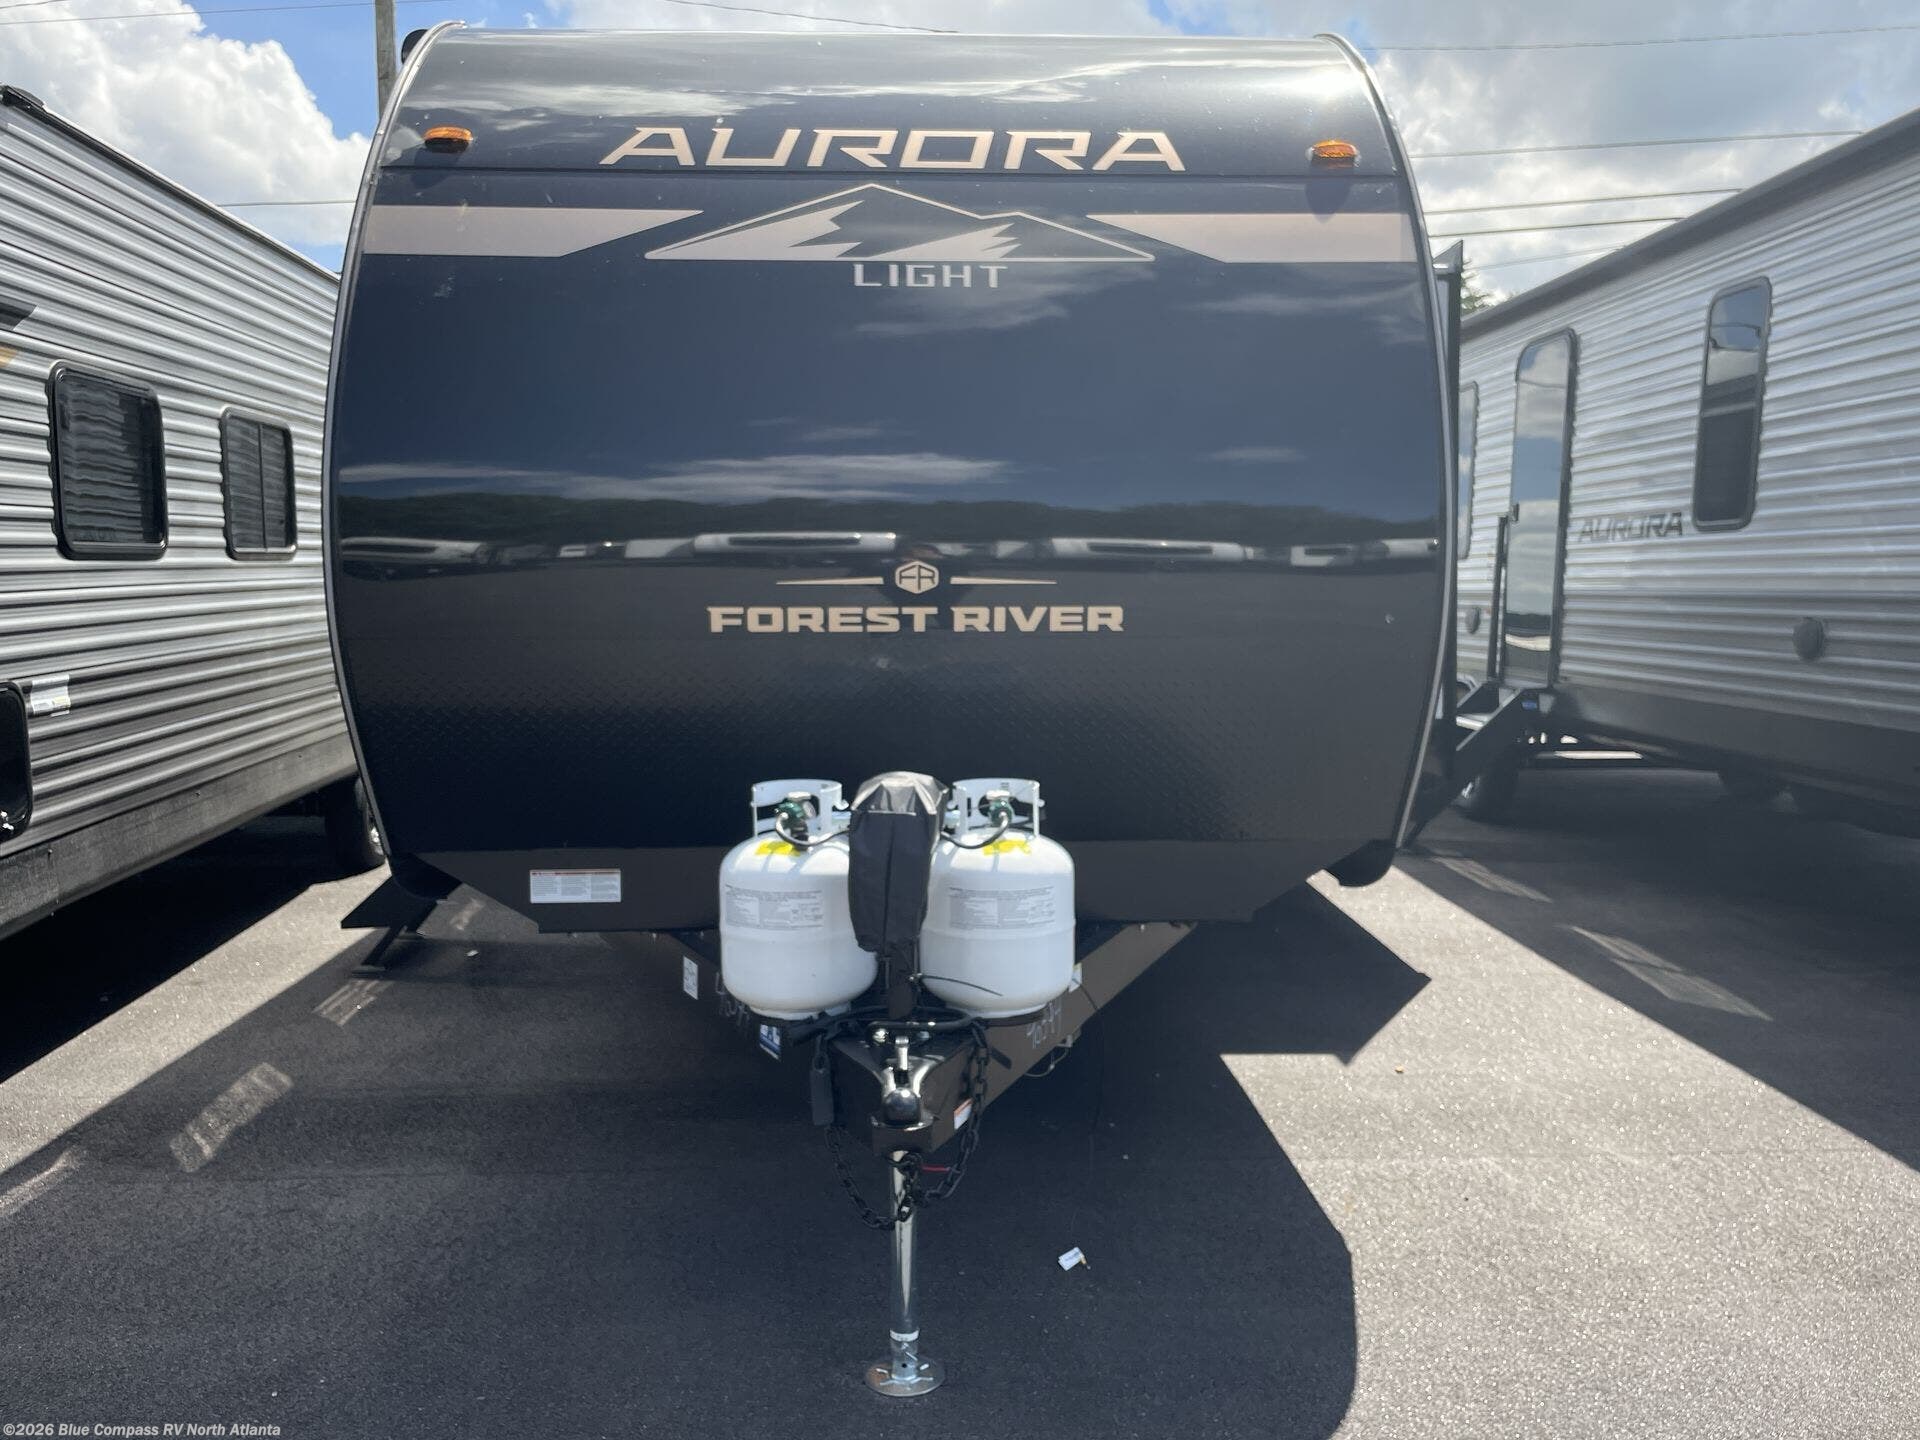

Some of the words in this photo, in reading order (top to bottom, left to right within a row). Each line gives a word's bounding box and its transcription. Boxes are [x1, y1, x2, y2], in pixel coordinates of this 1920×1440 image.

[599, 126, 1186, 171] AURORA
[853, 263, 1008, 288] LIGHT
[1578, 511, 1684, 543] AURORA
[706, 605, 939, 634] FOREST
[951, 605, 1125, 633] RIVER
